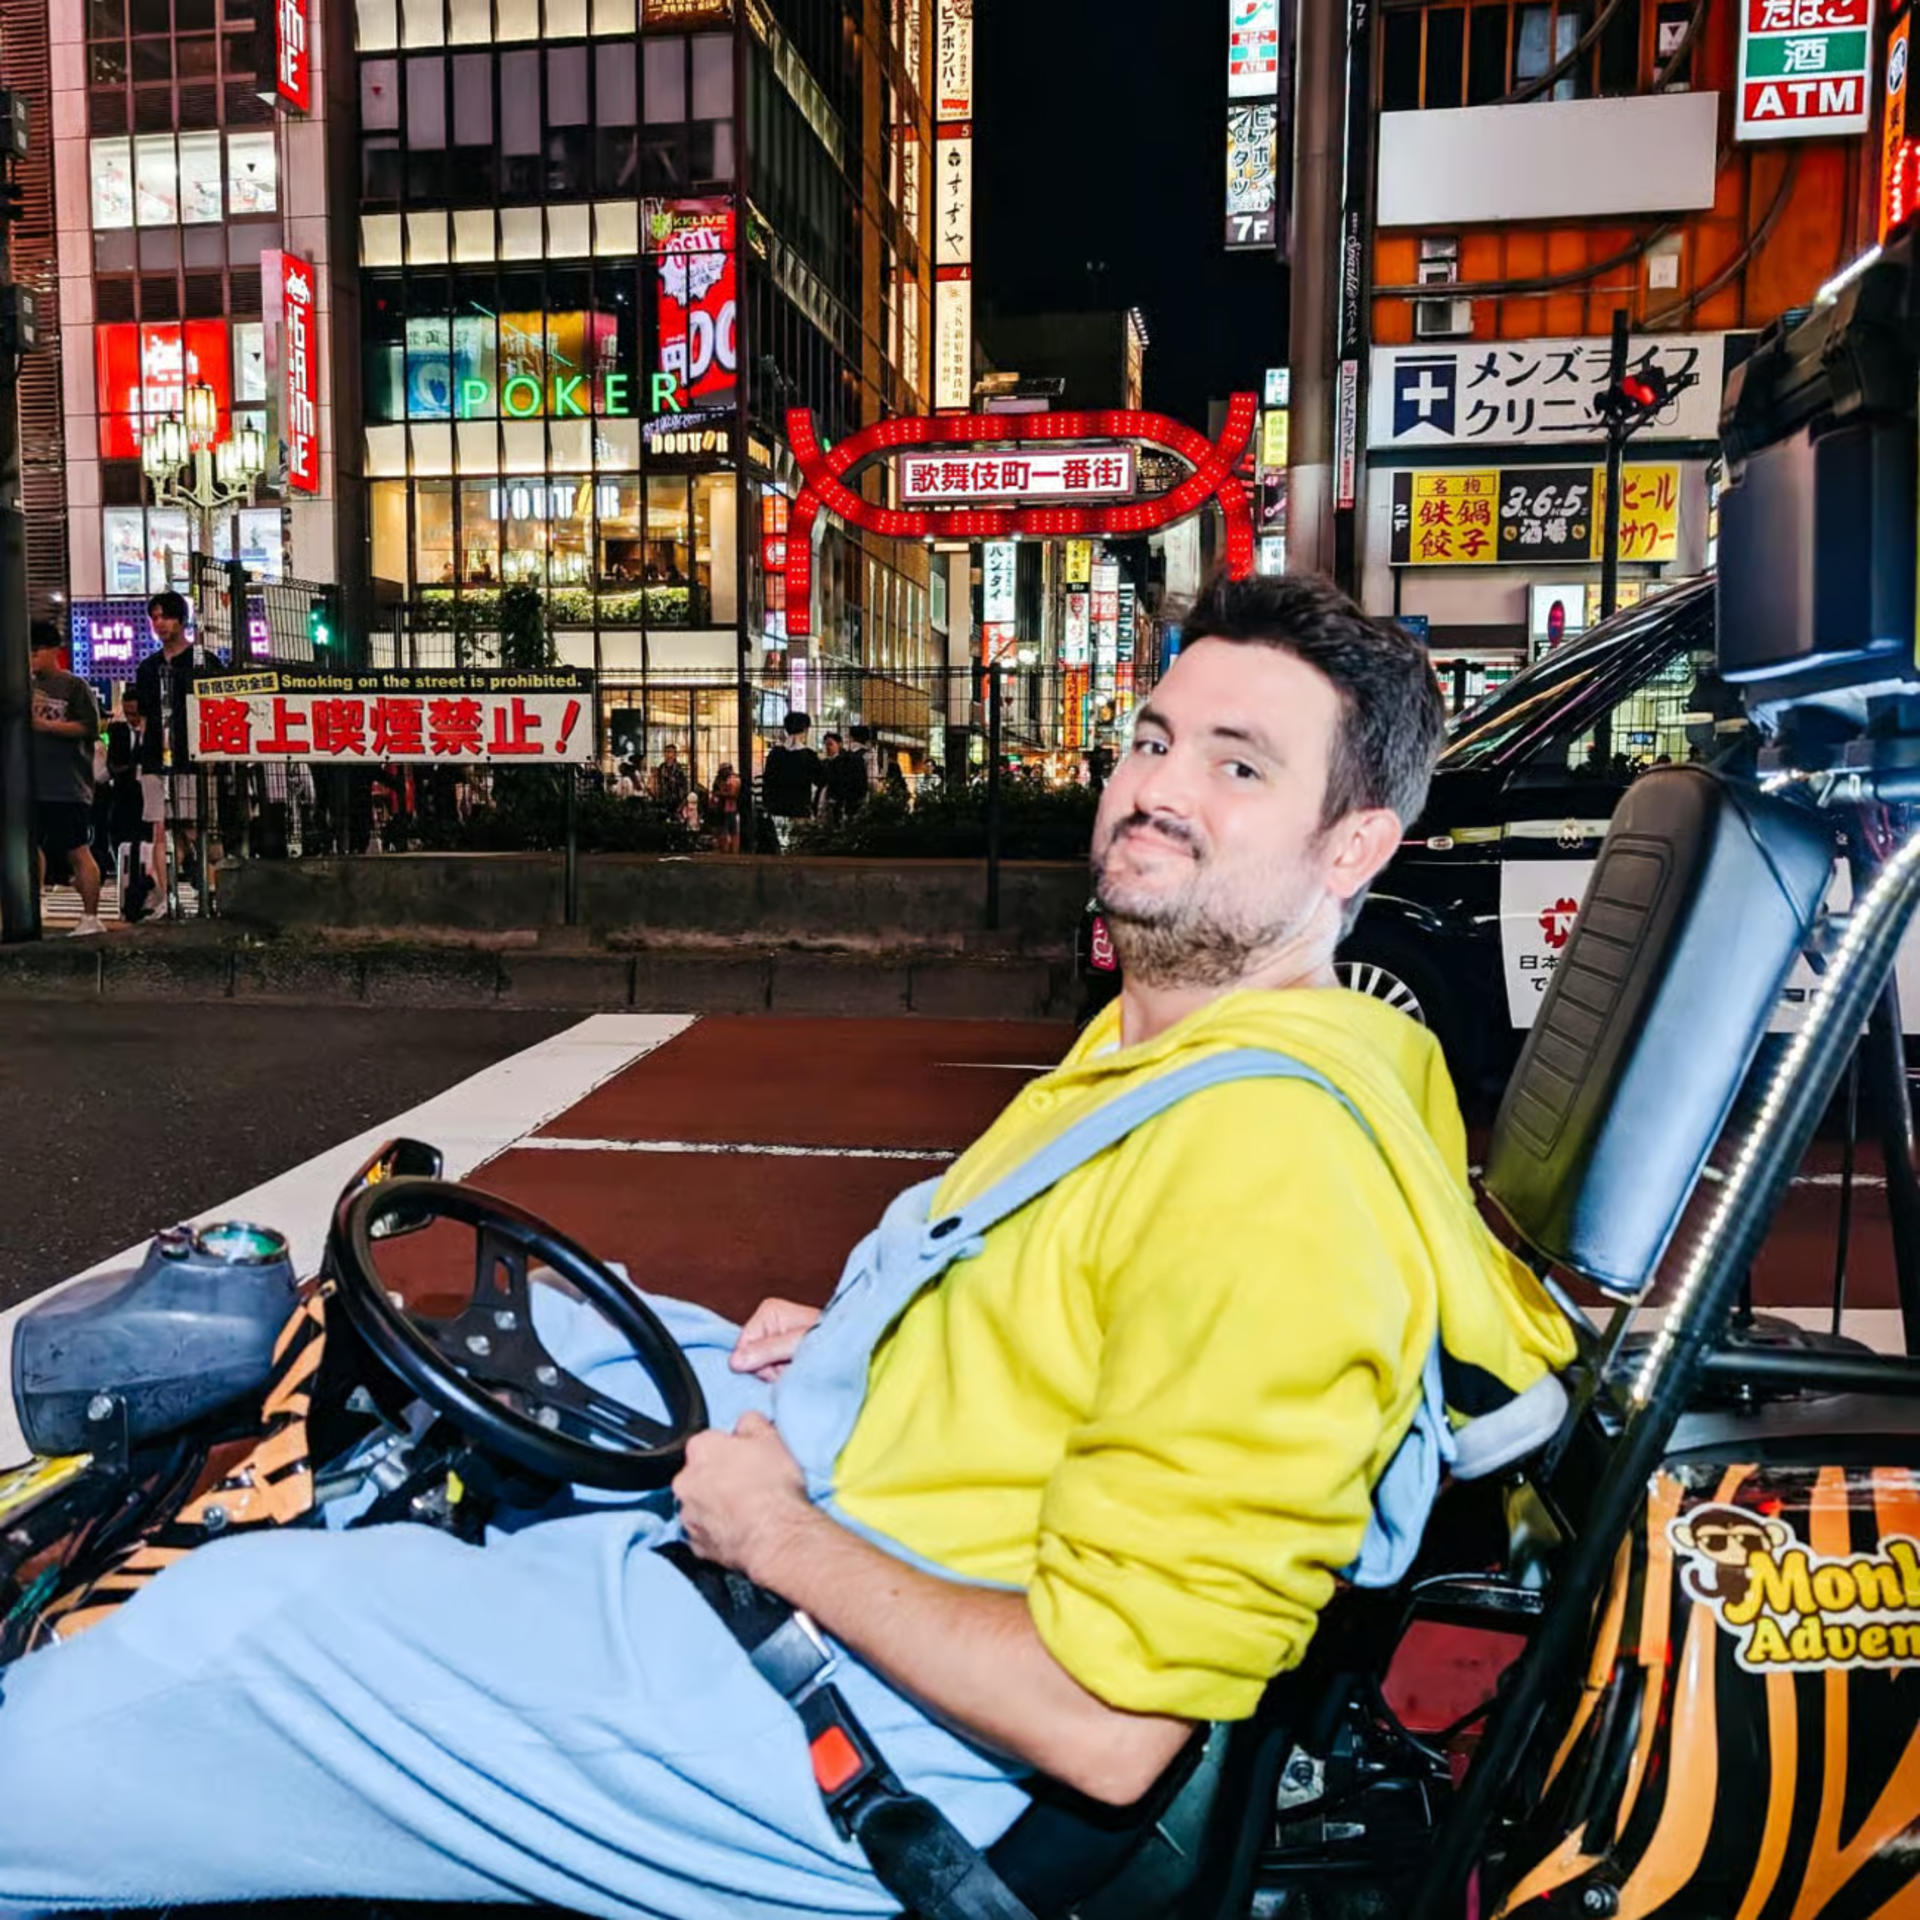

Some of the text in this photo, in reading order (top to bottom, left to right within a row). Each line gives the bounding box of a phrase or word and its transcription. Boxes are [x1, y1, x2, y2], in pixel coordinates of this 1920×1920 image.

[1783, 37, 1829, 73] 酒
[1752, 80, 1857, 119] ATM
[1232, 215, 1270, 242] 7F
[959, 267, 968, 279] 4
[461, 372, 681, 419] POKER
[651, 430, 729, 455] DOUTOR
[911, 458, 1123, 493] 歌舞伎町一番街
[1433, 479, 1481, 495] 名物
[490, 482, 620, 521] DOUTOR
[1621, 472, 1677, 511] ビール
[1392, 504, 1409, 532] 2F
[1418, 500, 1492, 528] 鉄鍋
[1418, 528, 1491, 558] 餃子
[1620, 519, 1675, 555] サワー
[91, 622, 133, 640] Let's
[281, 673, 583, 691] Smoking on the street is prohibited.
[198, 696, 581, 755] 路上喫煙禁止！
